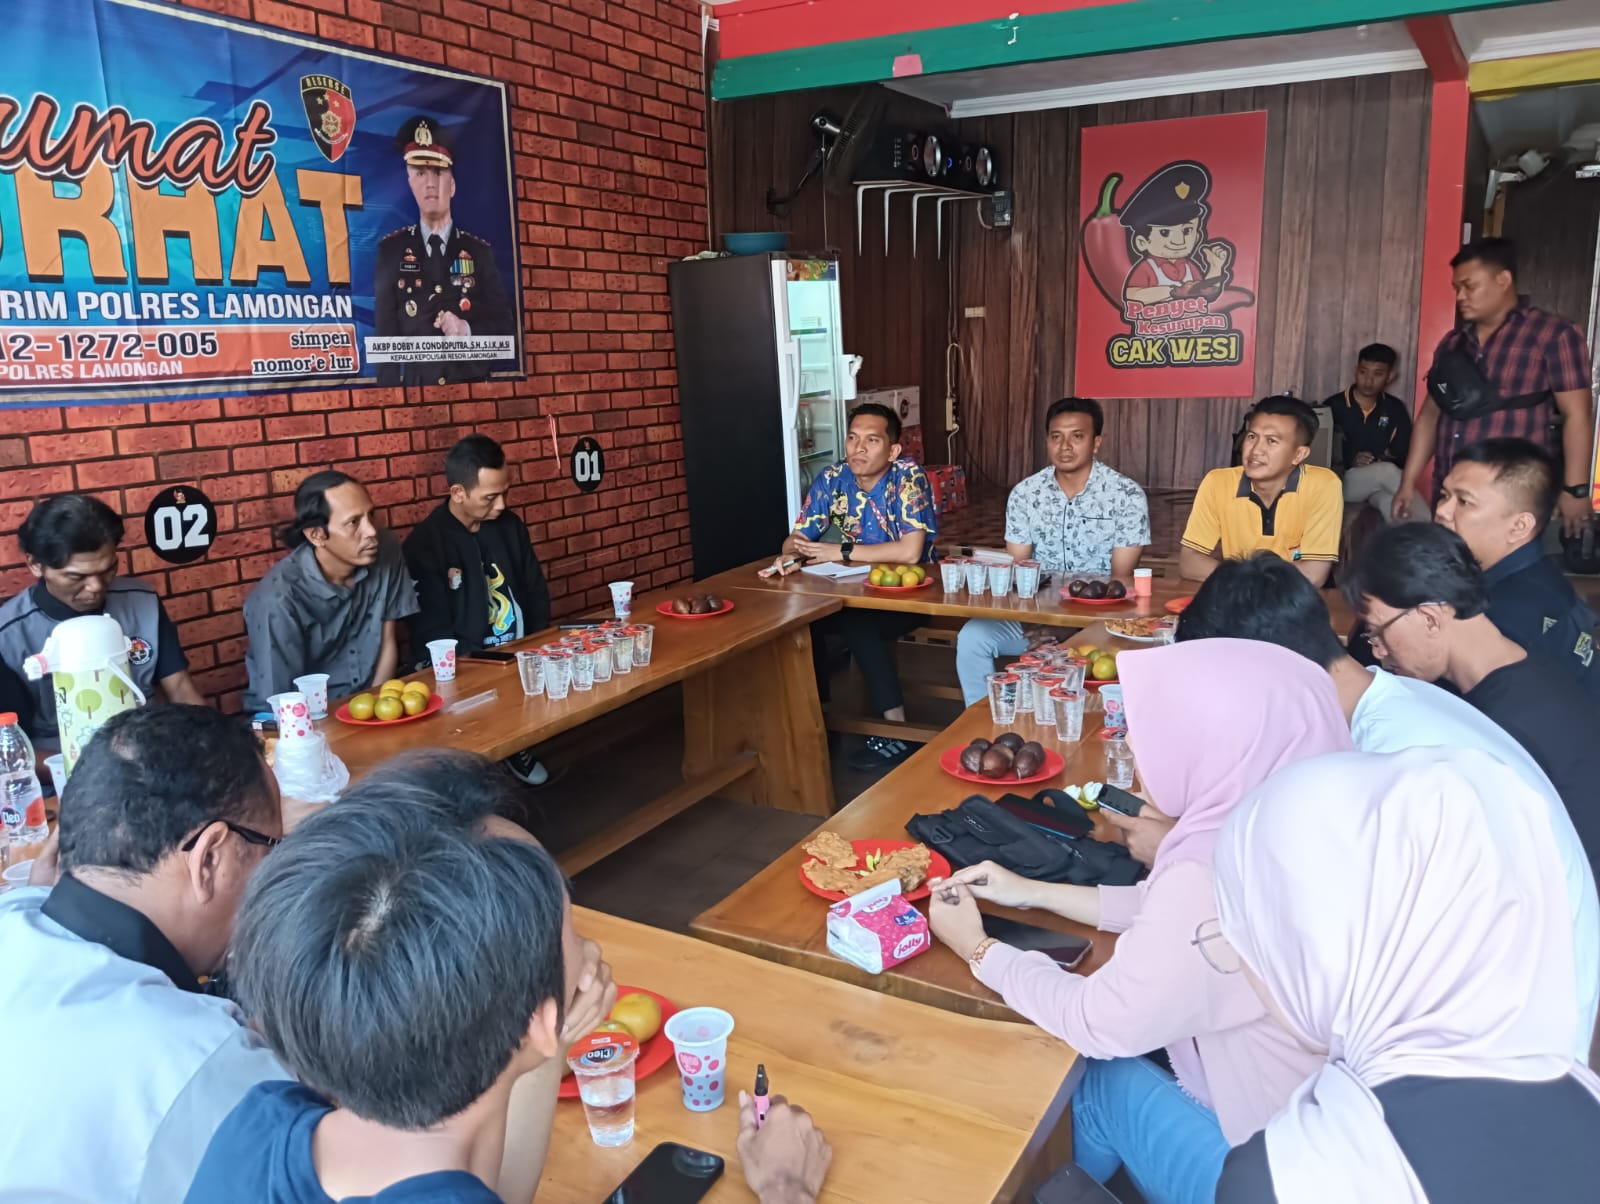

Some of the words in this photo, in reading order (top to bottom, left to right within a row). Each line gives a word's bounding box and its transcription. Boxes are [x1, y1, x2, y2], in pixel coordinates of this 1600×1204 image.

[0, 138, 363, 285] RHAT
[77, 291, 199, 320] POLRES
[207, 293, 352, 319] LAMONGAN
[1127, 298, 1207, 319] Penyet
[1138, 315, 1224, 334] Kesurupan
[291, 331, 351, 351] simpen
[373, 342, 390, 351] AKBP
[392, 342, 414, 350] BOBBY
[415, 342, 421, 350] A
[1112, 338, 1164, 362] CAK
[1169, 336, 1236, 362] WESI
[80, 361, 183, 379] LAMONGAN
[252, 356, 325, 374] nomor'e
[330, 354, 352, 370] lur
[575, 451, 601, 481] 01
[154, 503, 209, 551] 02
[897, 937, 922, 957] jolly
[587, 1047, 610, 1060] Cleo
